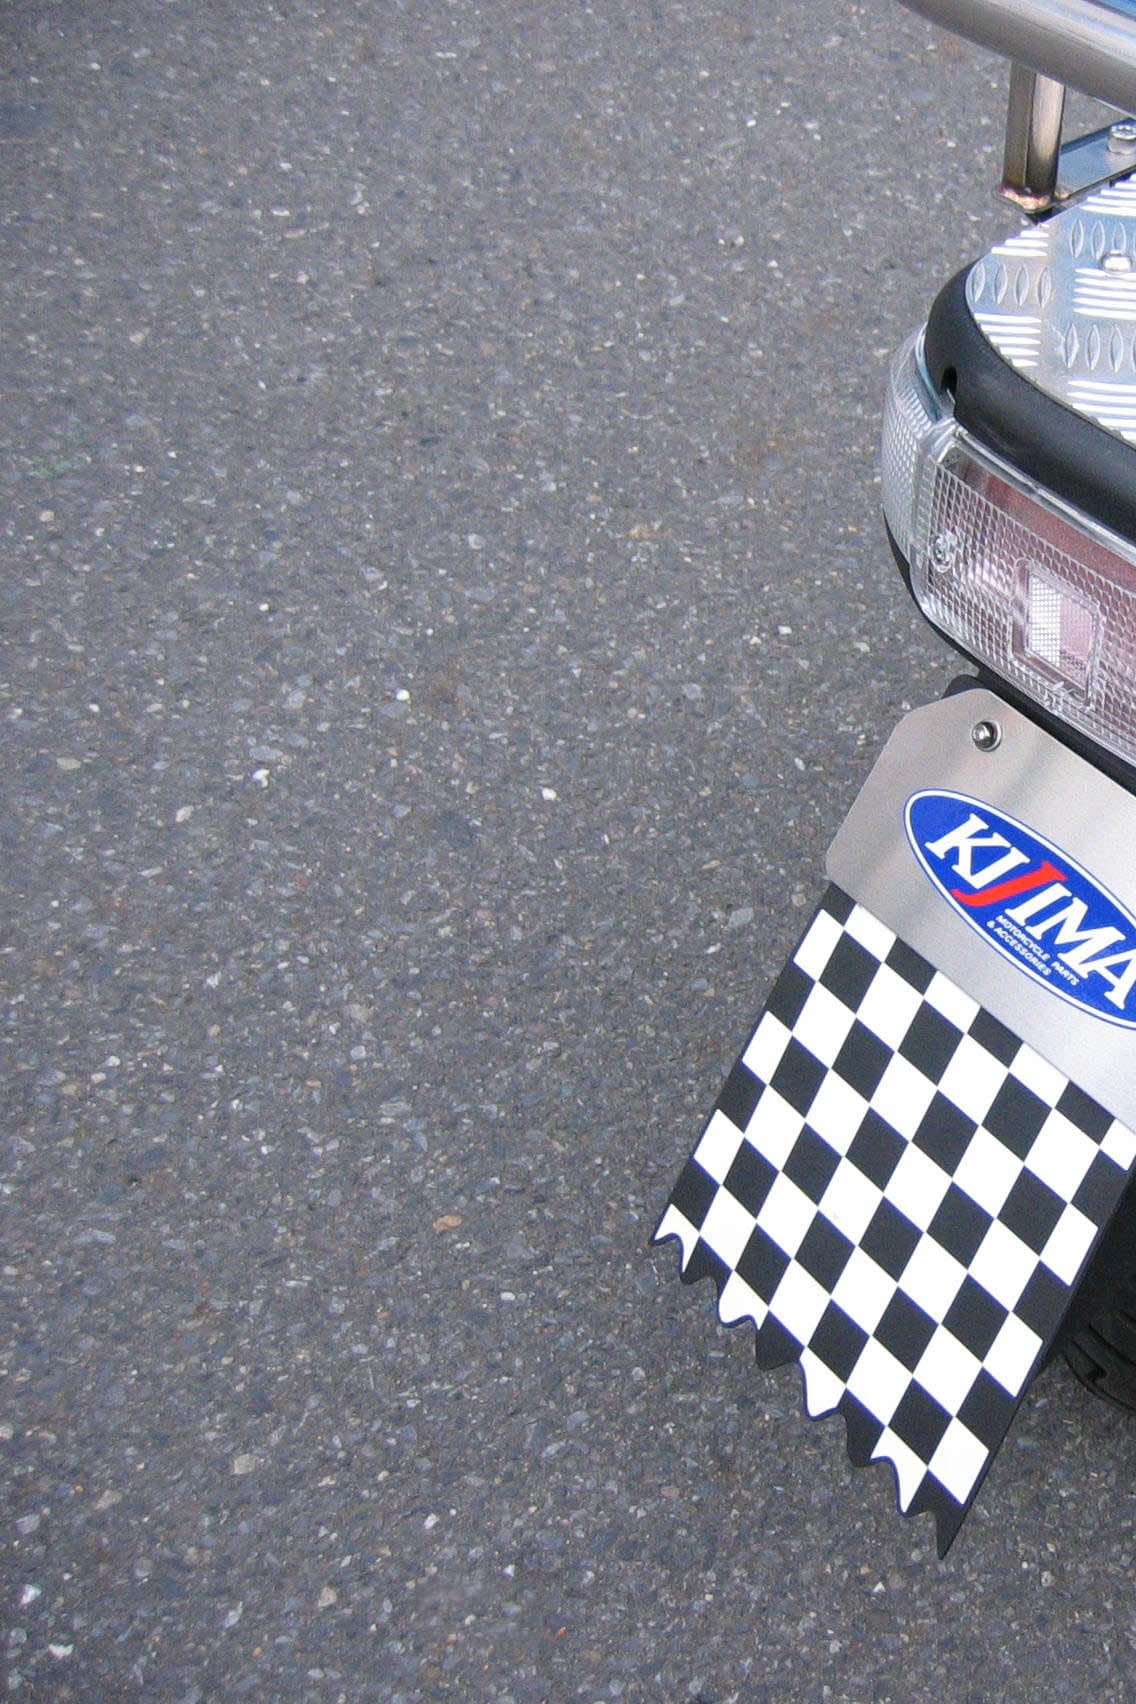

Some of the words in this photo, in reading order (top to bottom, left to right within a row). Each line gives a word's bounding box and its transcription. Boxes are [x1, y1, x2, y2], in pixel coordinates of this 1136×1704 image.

[994, 924, 1051, 976] ACCESSORIES
[995, 914, 1050, 961] MOTORCYCLE
[1051, 960, 1079, 986] PARTS
